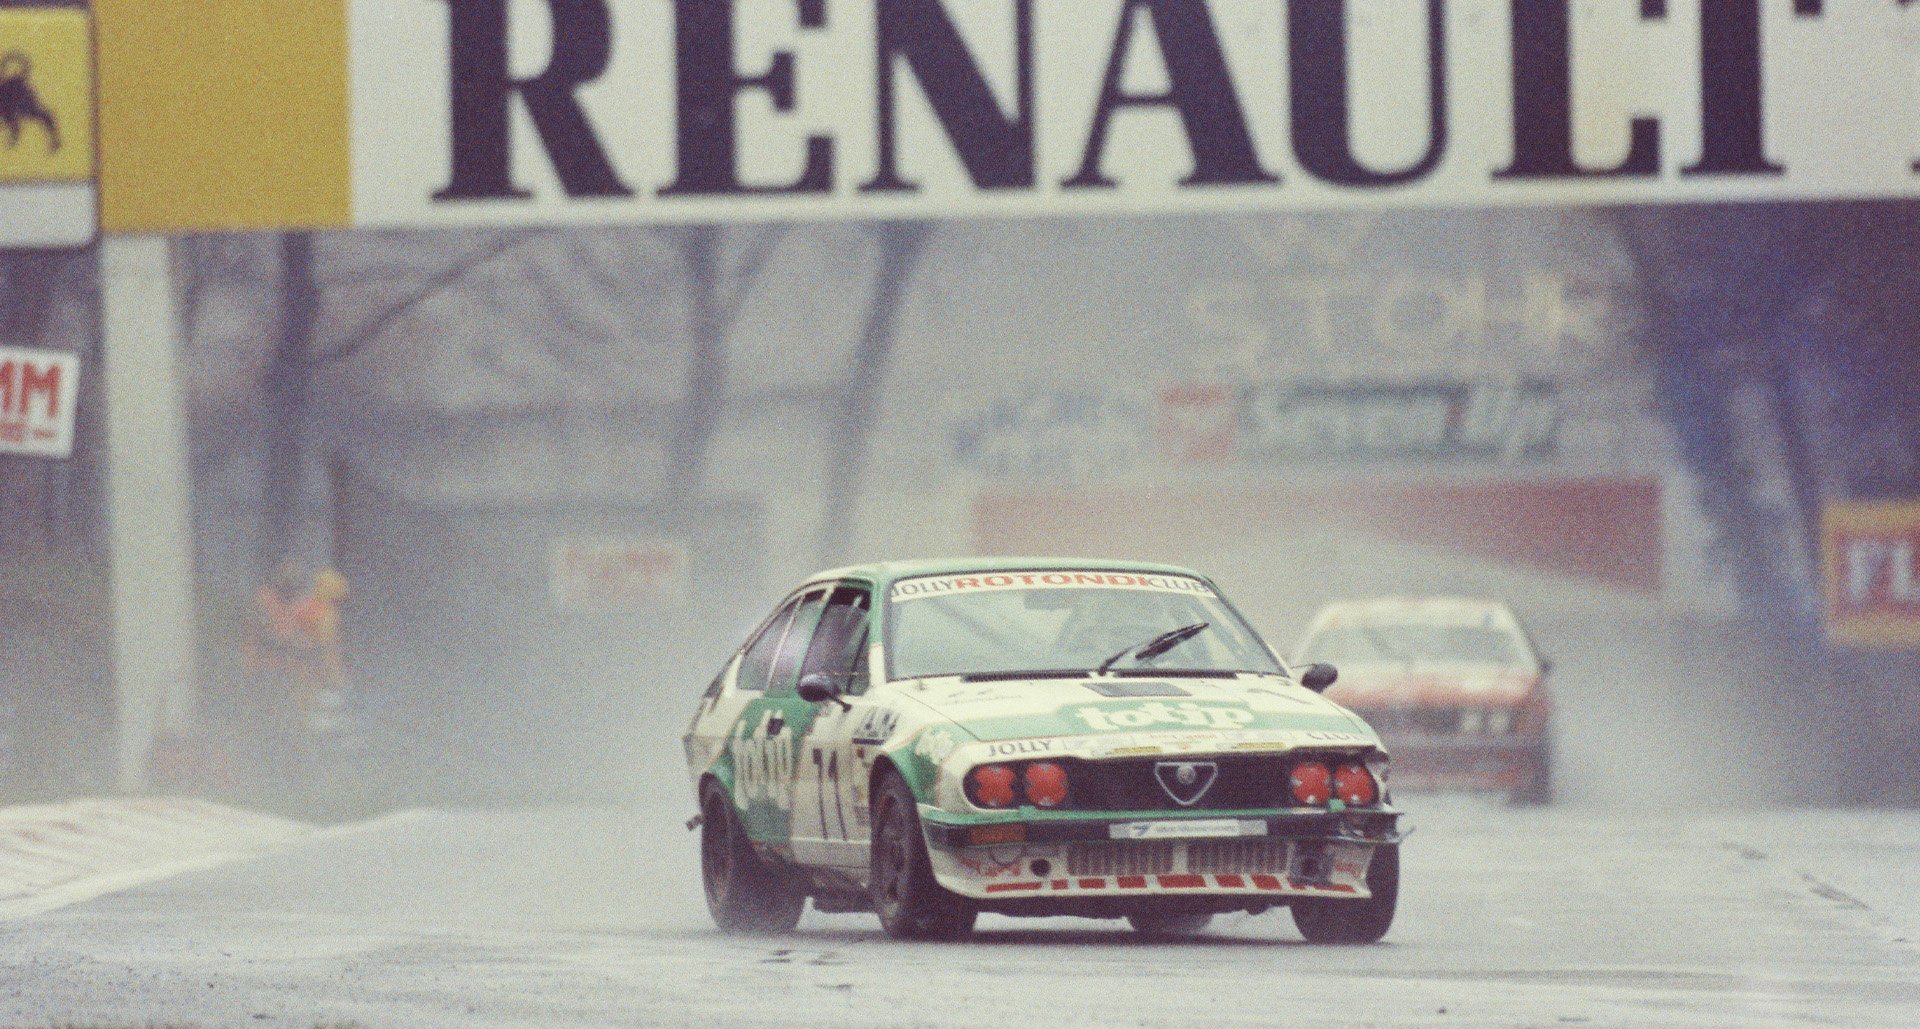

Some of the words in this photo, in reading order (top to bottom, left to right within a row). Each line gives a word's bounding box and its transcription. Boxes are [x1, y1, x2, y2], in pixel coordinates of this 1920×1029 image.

[430, 0, 1823, 202] RENAULT
[1077, 700, 1254, 731] totip
[988, 739, 1053, 757] JOLLY
